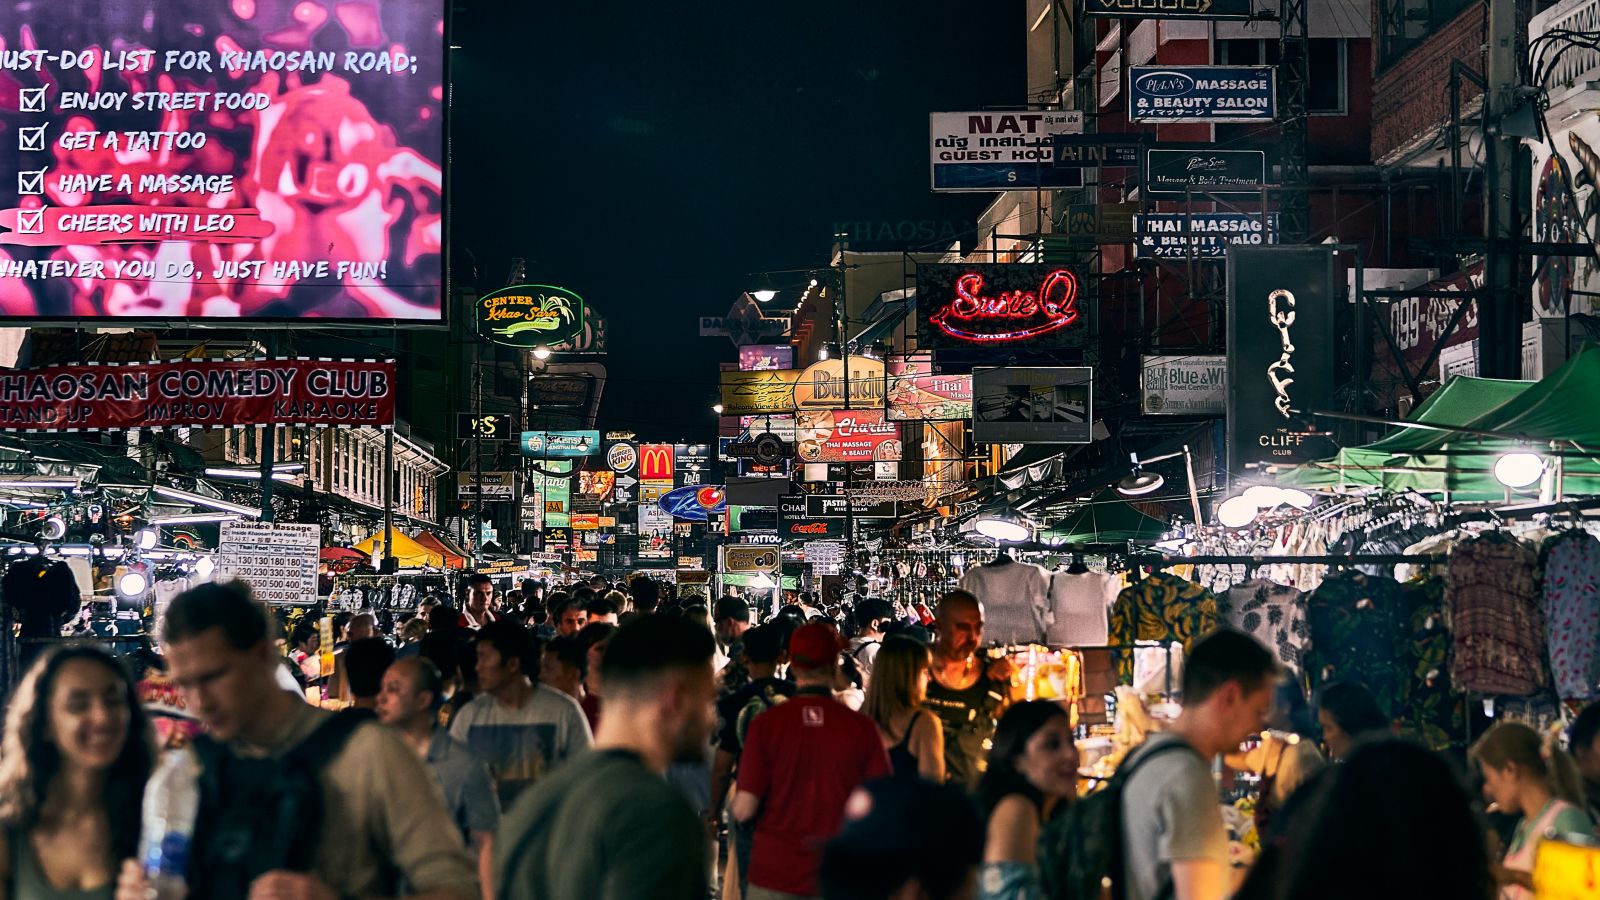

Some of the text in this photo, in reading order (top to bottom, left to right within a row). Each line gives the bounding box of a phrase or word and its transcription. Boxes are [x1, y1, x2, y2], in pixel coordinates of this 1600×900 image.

[0, 50, 418, 73] UST-DO LIST FOR KHAOSAN ROAD;
[1196, 80, 1267, 90] MASSAGE
[60, 92, 270, 111] ENJOY STREET FOOD
[1137, 98, 1268, 108] & BEAUTY SALON
[968, 115, 1043, 134] NAT
[60, 131, 206, 151] GET A TATTOO
[940, 151, 1052, 160] GUEST HOU
[59, 174, 234, 194] HAVE A MASSAGE
[58, 214, 235, 232] CHEERS WITH LEO
[1142, 236, 1154, 245] &
[0, 260, 388, 281] WHATEVER YOU DO, JUST HAVE FUN!
[952, 269, 1079, 318] Susie Q
[484, 296, 533, 308] CENTER
[485, 304, 560, 320] Khao Sarn
[1170, 368, 1198, 384] Blue
[1201, 373, 1208, 384] &
[0, 368, 388, 401] HAOSAN COMEDY CLUB
[931, 380, 962, 392] Thai
[2, 400, 377, 423] TAND UP IMPROV KARAOKE
[836, 417, 897, 436] Charlie
[1259, 435, 1303, 446] CLIFF
[612, 454, 632, 465] KING
[229, 521, 312, 532] Sabaidee Massage
[238, 556, 252, 565] 130
[254, 557, 268, 565] 130
[270, 558, 285, 566] 180
[286, 558, 300, 567] 180
[237, 567, 252, 575] 230
[253, 568, 268, 576] 230
[269, 568, 284, 577] 330
[286, 569, 300, 578] 300
[269, 580, 284, 588] 500
[285, 580, 300, 589] 400
[268, 591, 283, 599] 600
[285, 591, 300, 600] 500
[301, 587, 315, 595] 250
